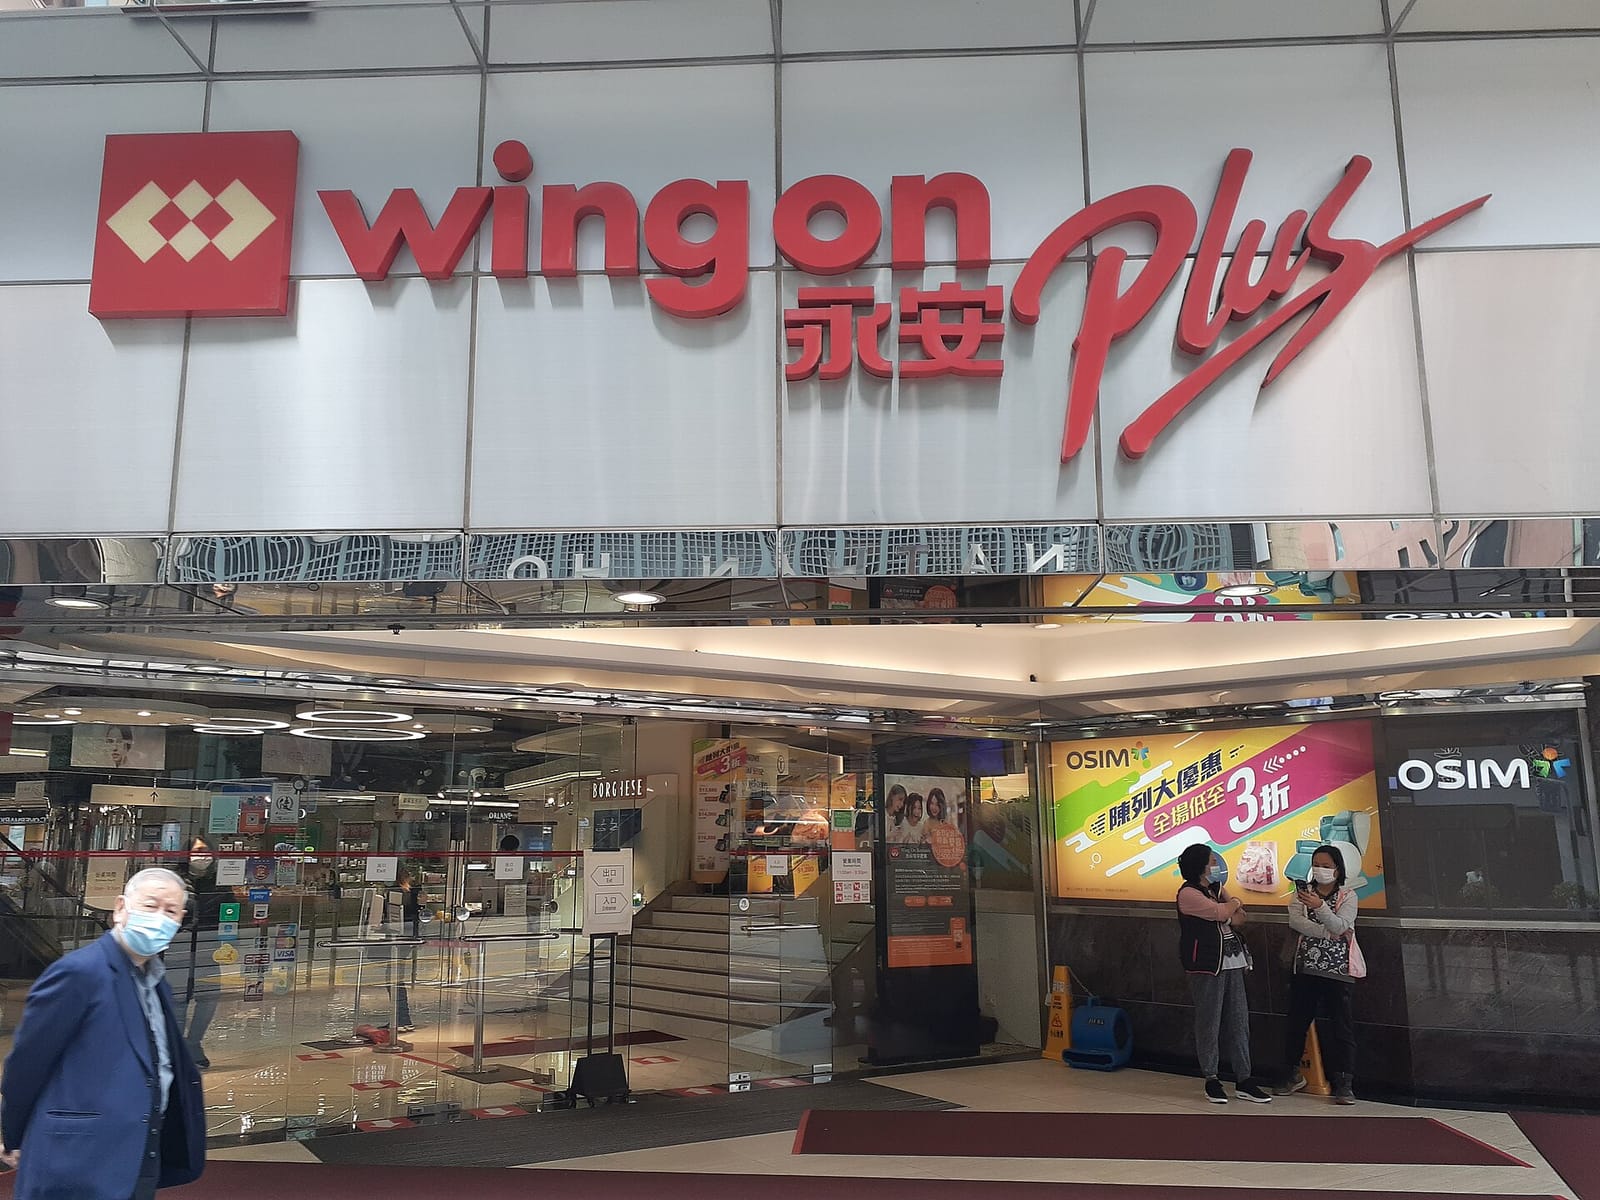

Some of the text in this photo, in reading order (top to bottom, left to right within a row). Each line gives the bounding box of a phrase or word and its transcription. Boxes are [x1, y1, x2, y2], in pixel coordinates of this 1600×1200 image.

[317, 139, 992, 319] wing on
[784, 280, 1006, 382] 永安
[1066, 747, 1130, 770] OSIM
[1397, 758, 1531, 791] OSIM
[1108, 748, 1224, 832] 陳列大優惠
[1152, 765, 1292, 838] 全場低至 3折
[602, 868, 617, 877] 出口
[603, 896, 617, 905] 入口
